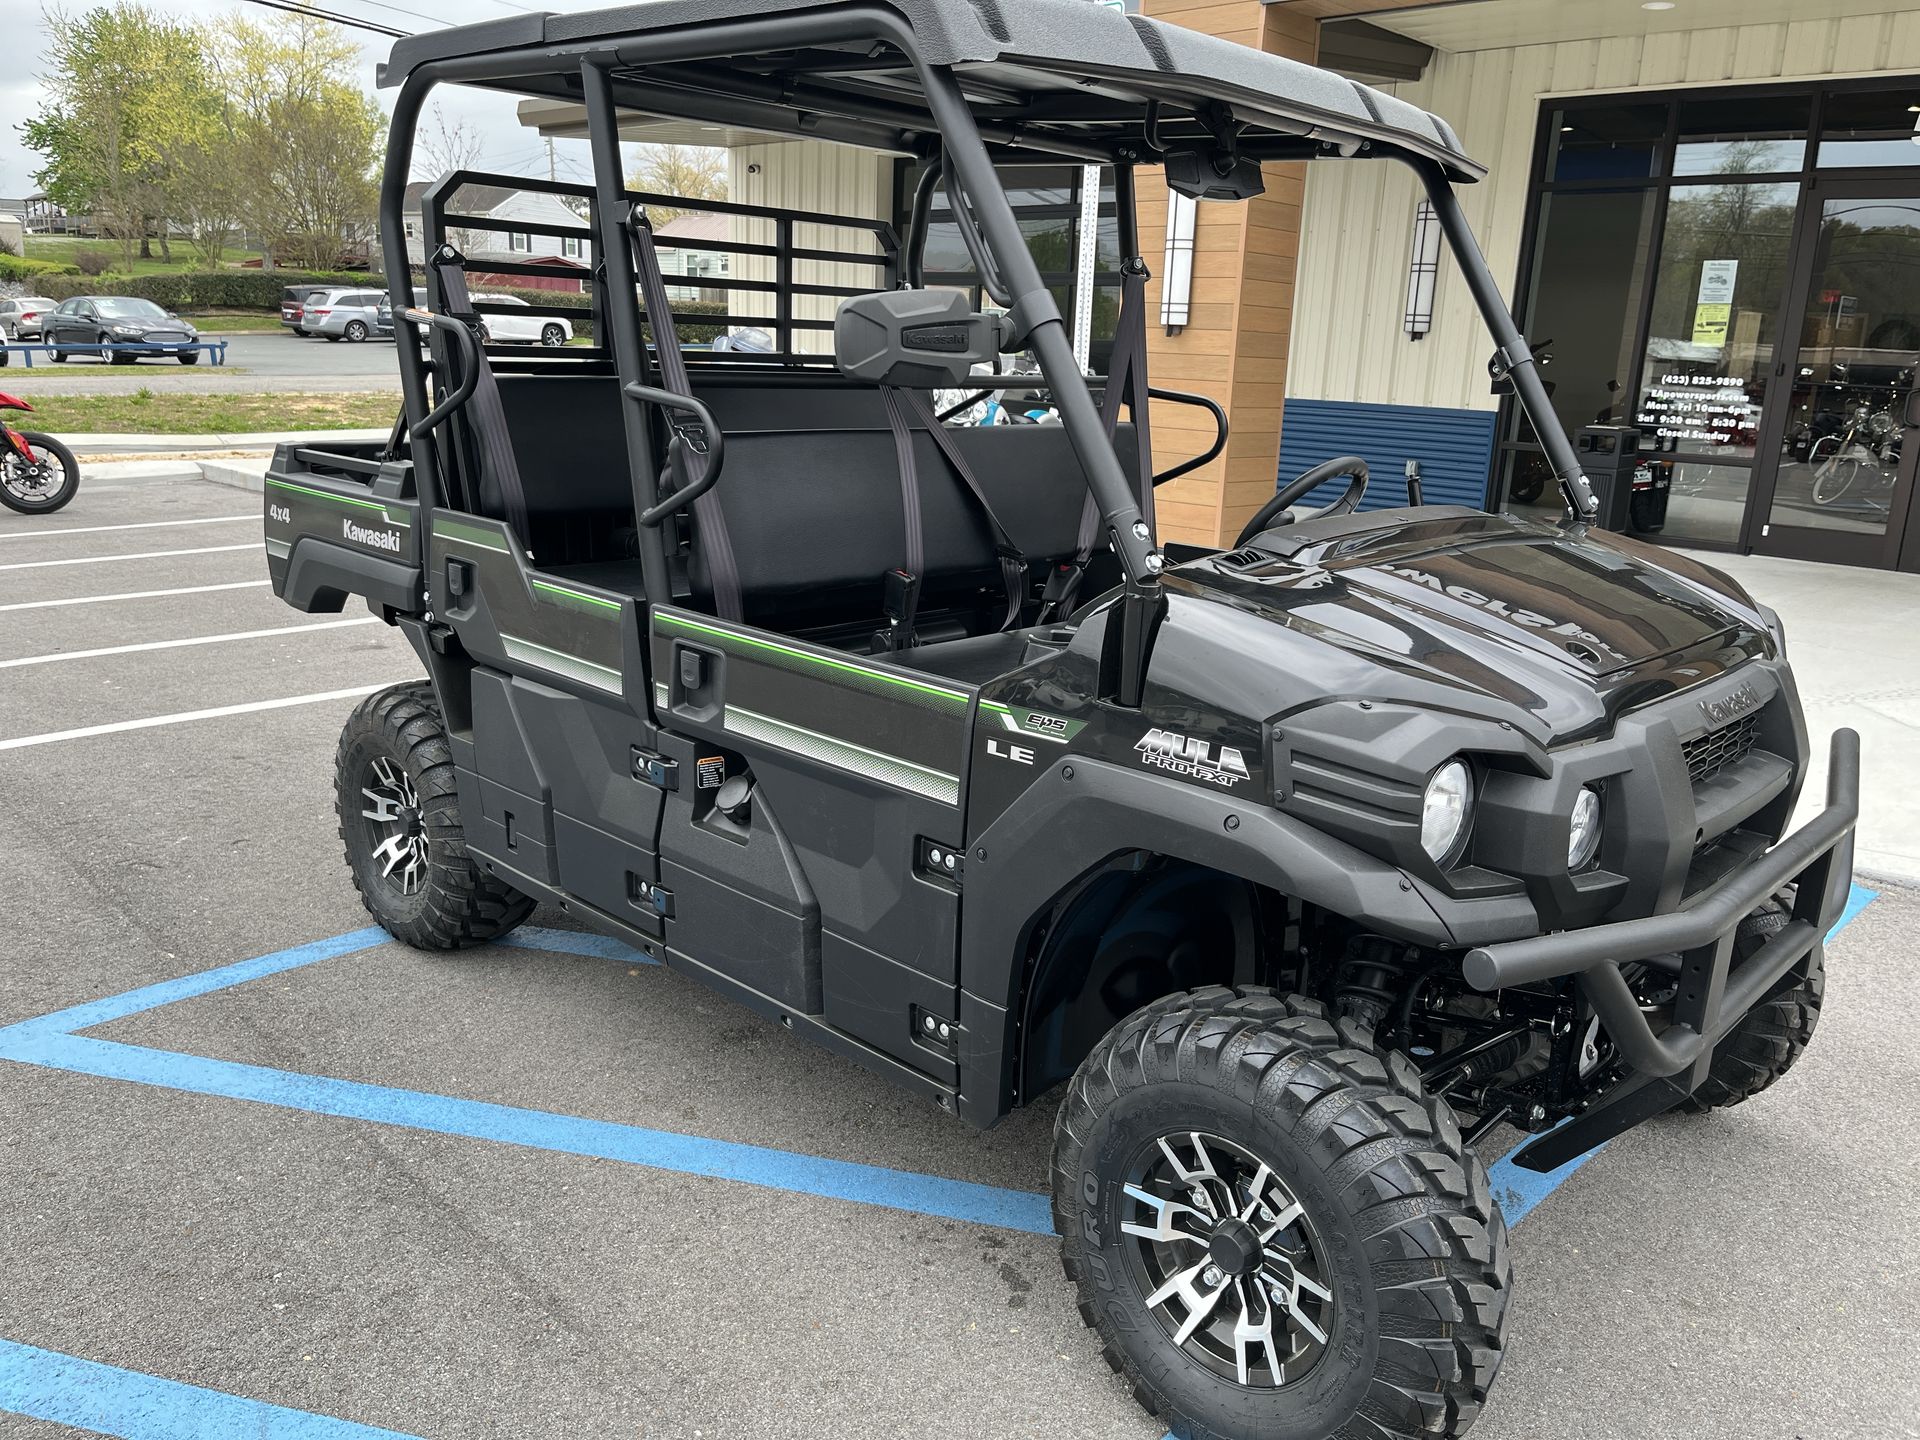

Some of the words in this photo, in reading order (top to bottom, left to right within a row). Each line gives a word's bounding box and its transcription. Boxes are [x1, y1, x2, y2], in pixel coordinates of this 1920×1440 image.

[906, 330, 967, 345] Kawasaki
[1661, 374, 1690, 386] (423)
[1691, 376, 1744, 387] 825-9890
[1650, 389, 1750, 402] EApowersports.com
[1645, 401, 1668, 410] Mon
[1677, 402, 1692, 412] Fri
[1695, 403, 1751, 415] 10am-6pm
[1637, 413, 1655, 423] Sat
[1659, 415, 1683, 425] 9:30
[1685, 417, 1701, 426] am
[1711, 418, 1737, 428] 5:30
[1737, 420, 1756, 430] pm
[1656, 428, 1690, 438] Closed
[1691, 430, 1731, 442] Sunday
[269, 503, 291, 524] 4x4
[343, 518, 401, 553] Kawasaki
[1696, 680, 1761, 725] Kawasaki
[986, 738, 1035, 766] LE
[1133, 727, 1251, 780] MULE
[1141, 752, 1239, 787] PRO-FXT
[1081, 1170, 1139, 1333] DURO
